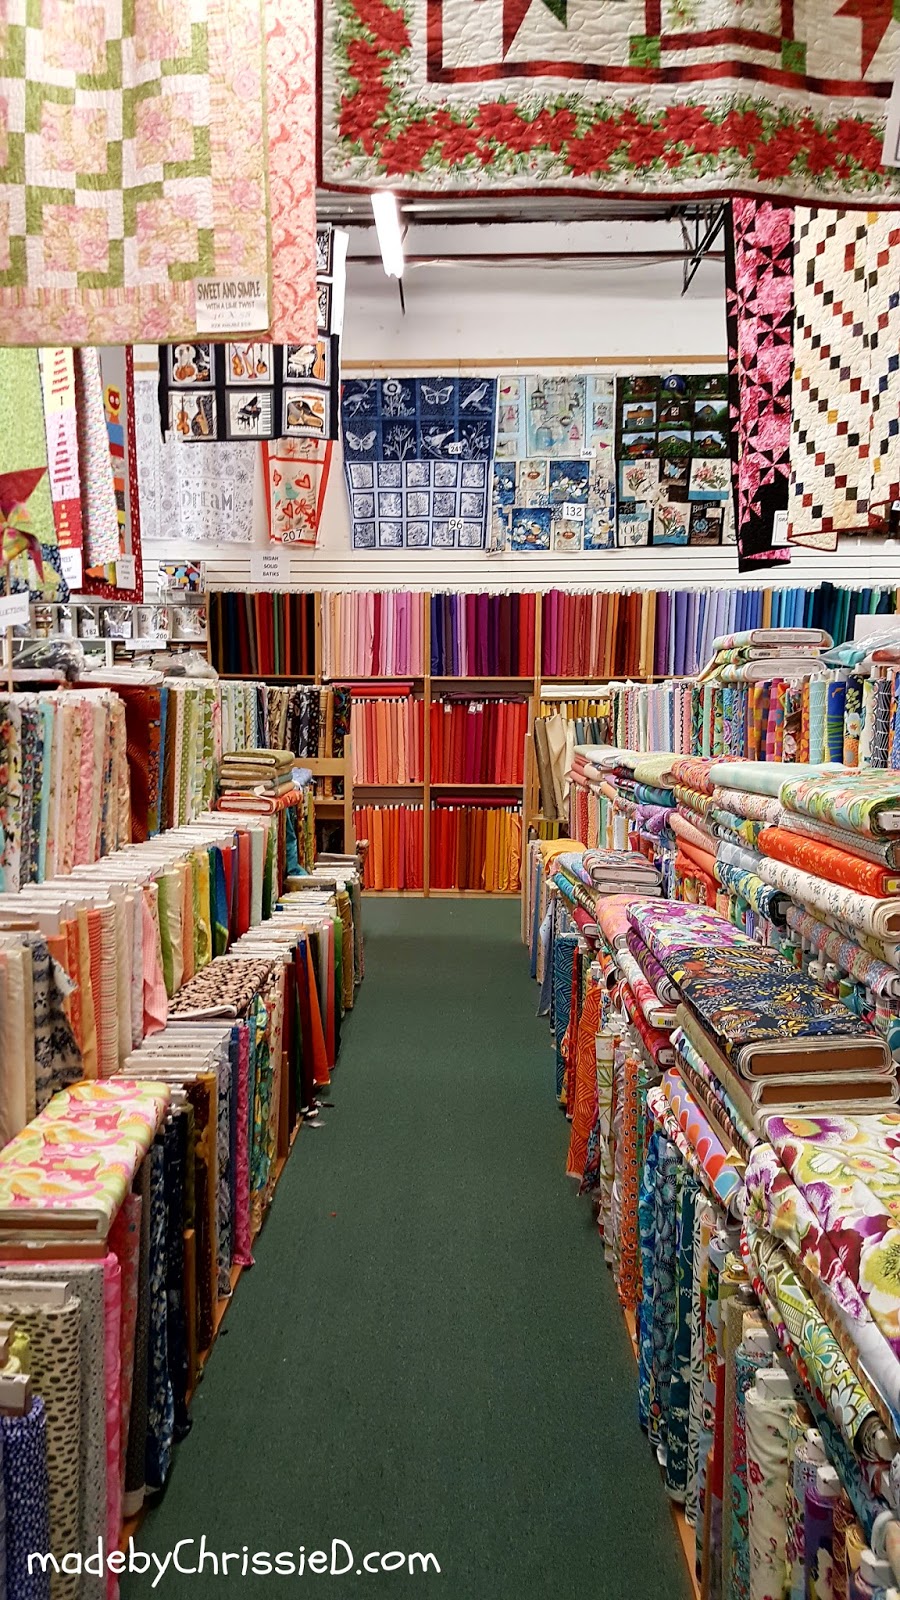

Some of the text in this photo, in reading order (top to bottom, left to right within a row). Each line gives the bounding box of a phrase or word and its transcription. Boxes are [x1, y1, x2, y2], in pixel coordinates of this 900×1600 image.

[197, 280, 260, 300] SWEET AND SIMPLE
[205, 302, 220, 310] WITH
[565, 506, 582, 517] 132
[450, 519, 463, 529] 96
[282, 528, 303, 542] 207
